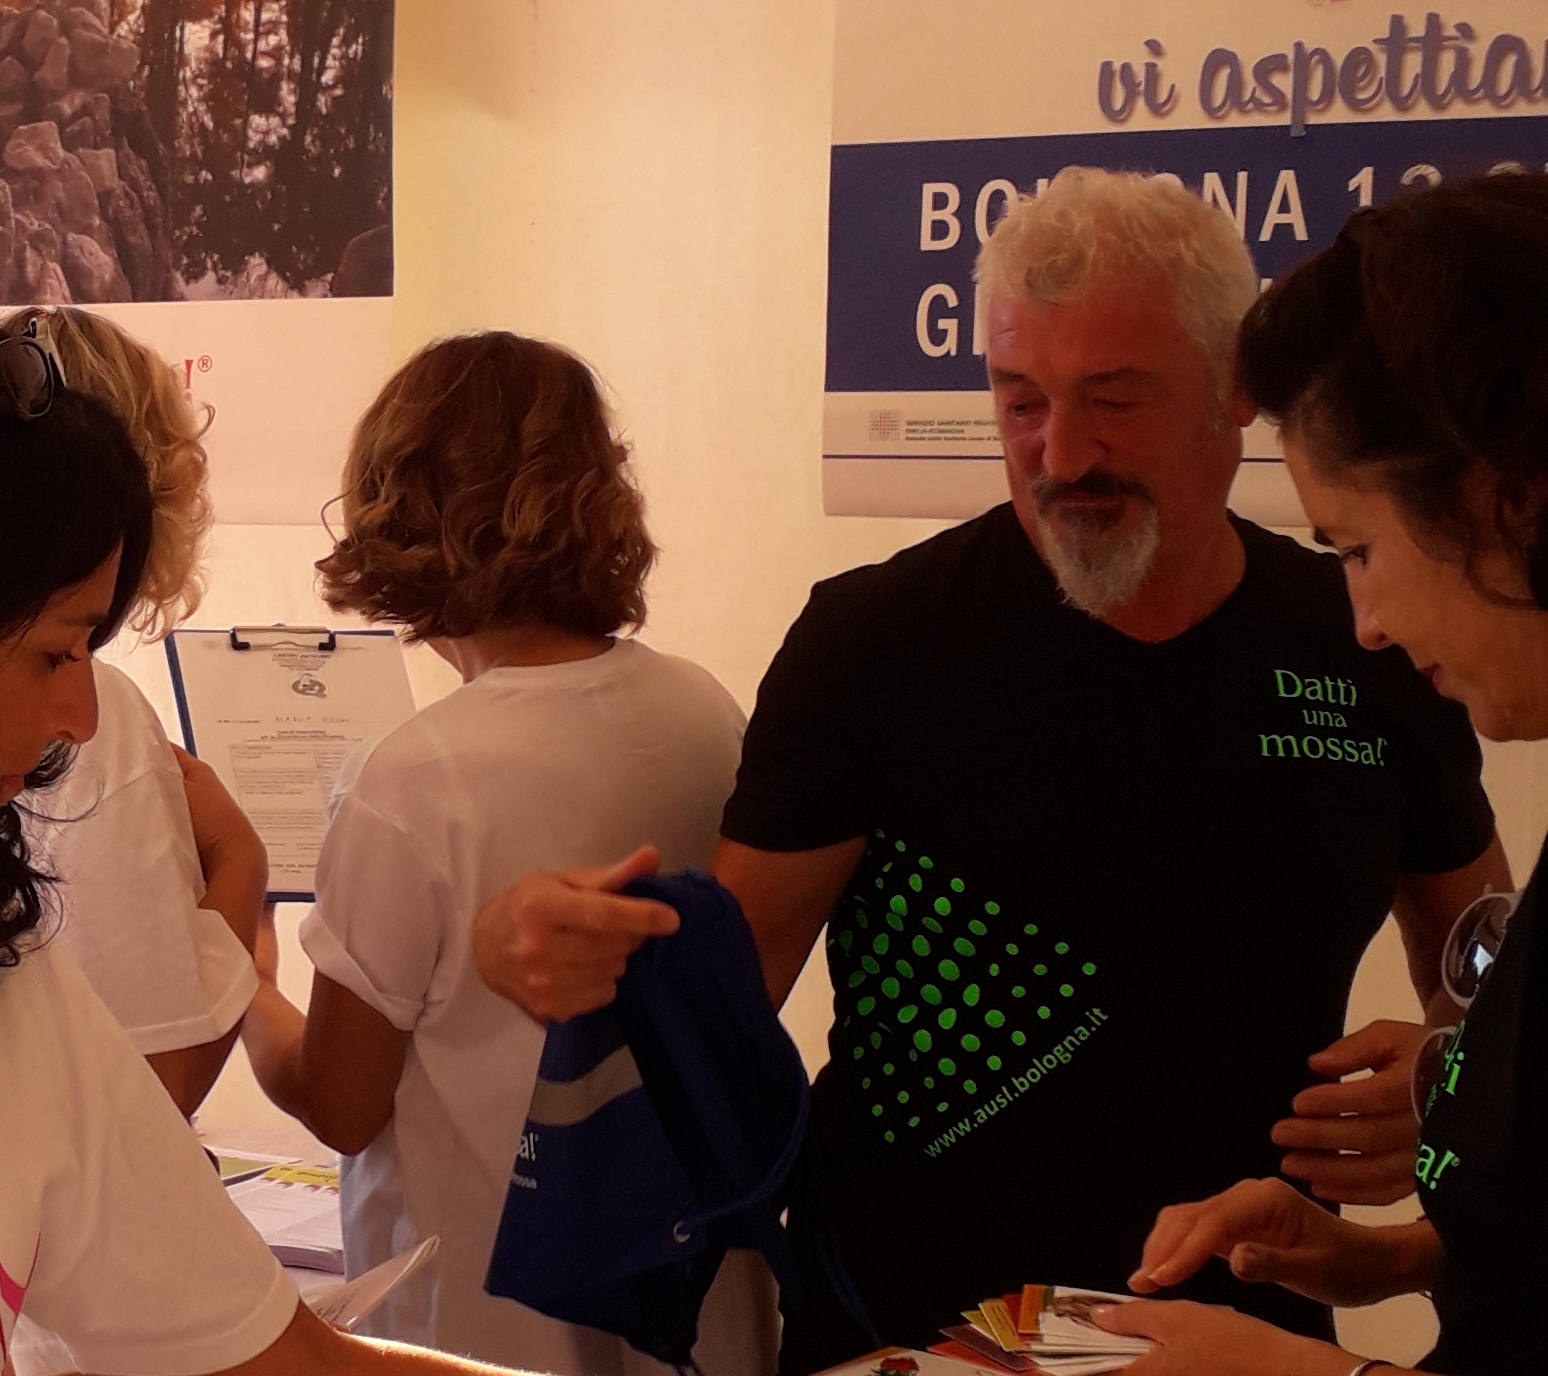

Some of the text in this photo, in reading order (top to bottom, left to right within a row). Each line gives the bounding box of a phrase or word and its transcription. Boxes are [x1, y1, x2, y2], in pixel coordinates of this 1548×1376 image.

[1098, 12, 1548, 137] vi aspettia
[1273, 668, 1358, 708] Datti
[1303, 708, 1348, 728] una
[1257, 732, 1388, 768] mossa!
[922, 1006, 1110, 1159] www.ausl.bologna.it
